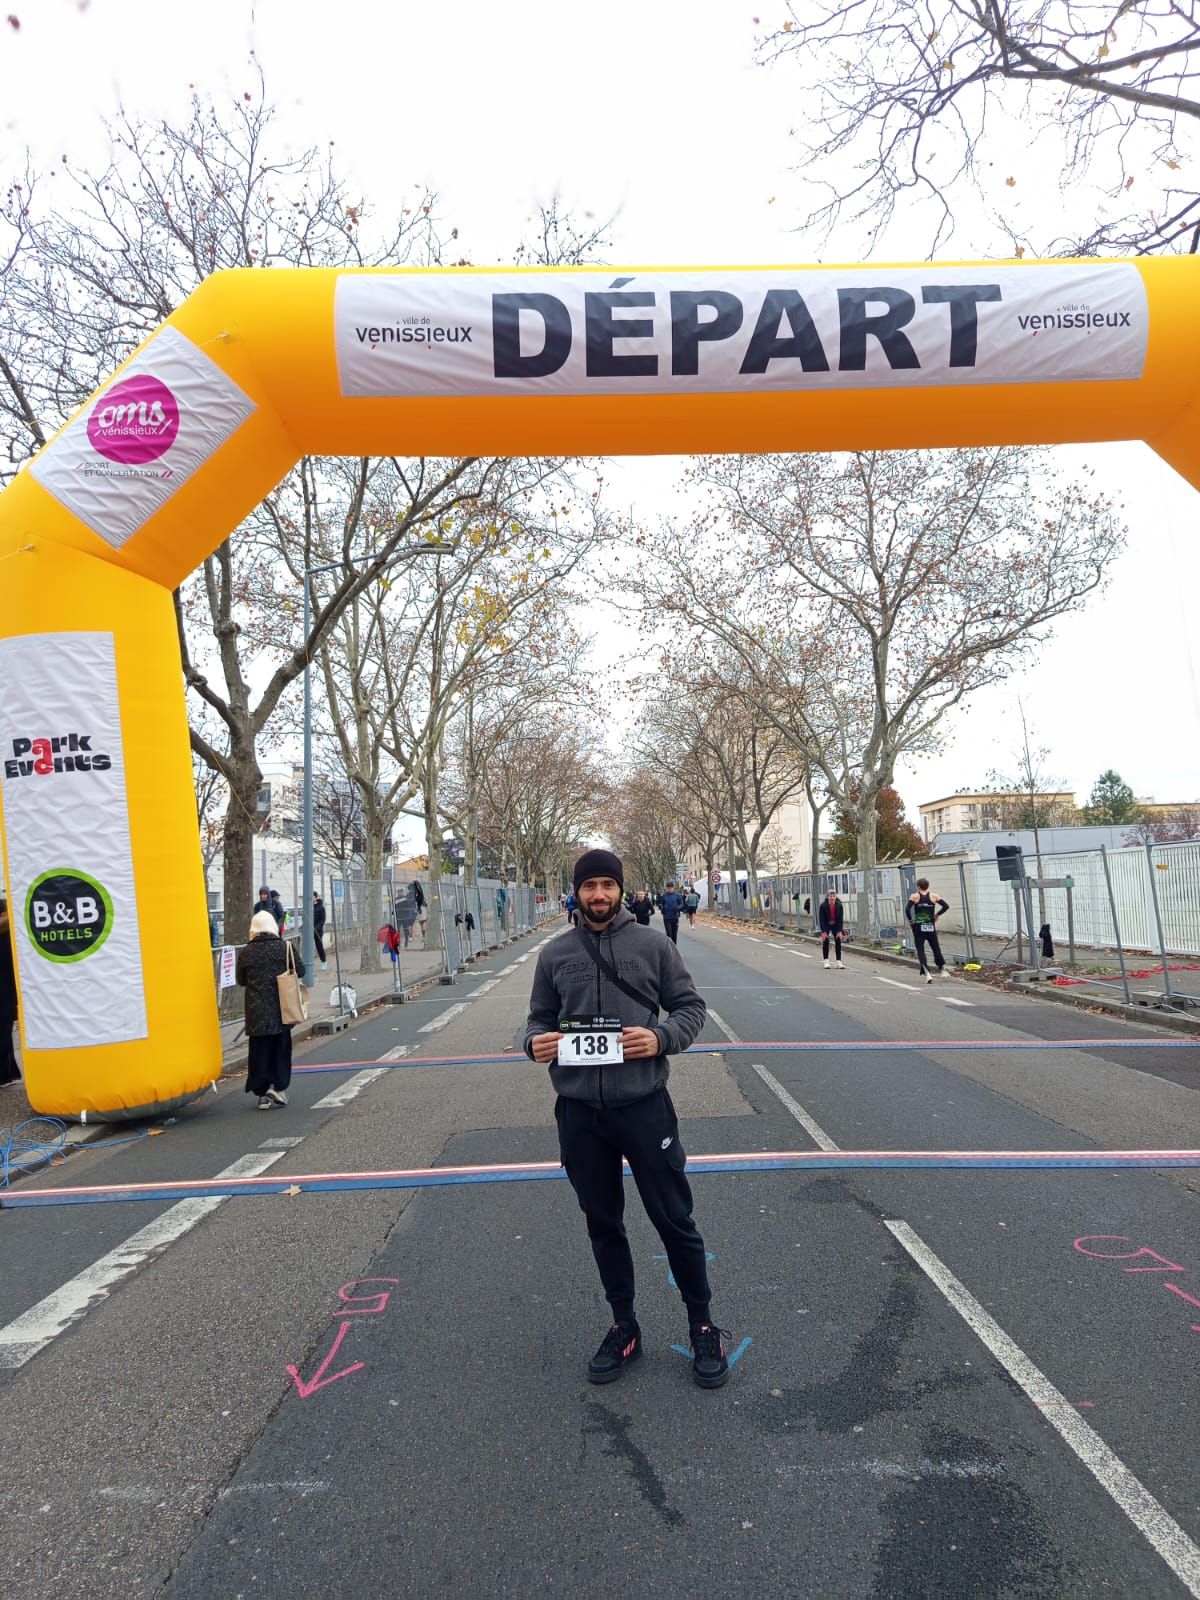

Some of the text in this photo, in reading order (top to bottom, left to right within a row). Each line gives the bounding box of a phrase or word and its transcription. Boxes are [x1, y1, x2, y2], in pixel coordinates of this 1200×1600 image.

[1062, 303, 1091, 313] ville de
[402, 316, 431, 325] ville de
[492, 277, 1002, 379] DÉPART
[98, 400, 166, 428] oms
[102, 426, 158, 436] vénissieux
[95, 470, 158, 478] CONCERTATION
[13, 733, 92, 757] Park
[33, 896, 99, 928] B&B
[41, 927, 93, 942] HOTELS
[571, 1035, 609, 1056] 138
